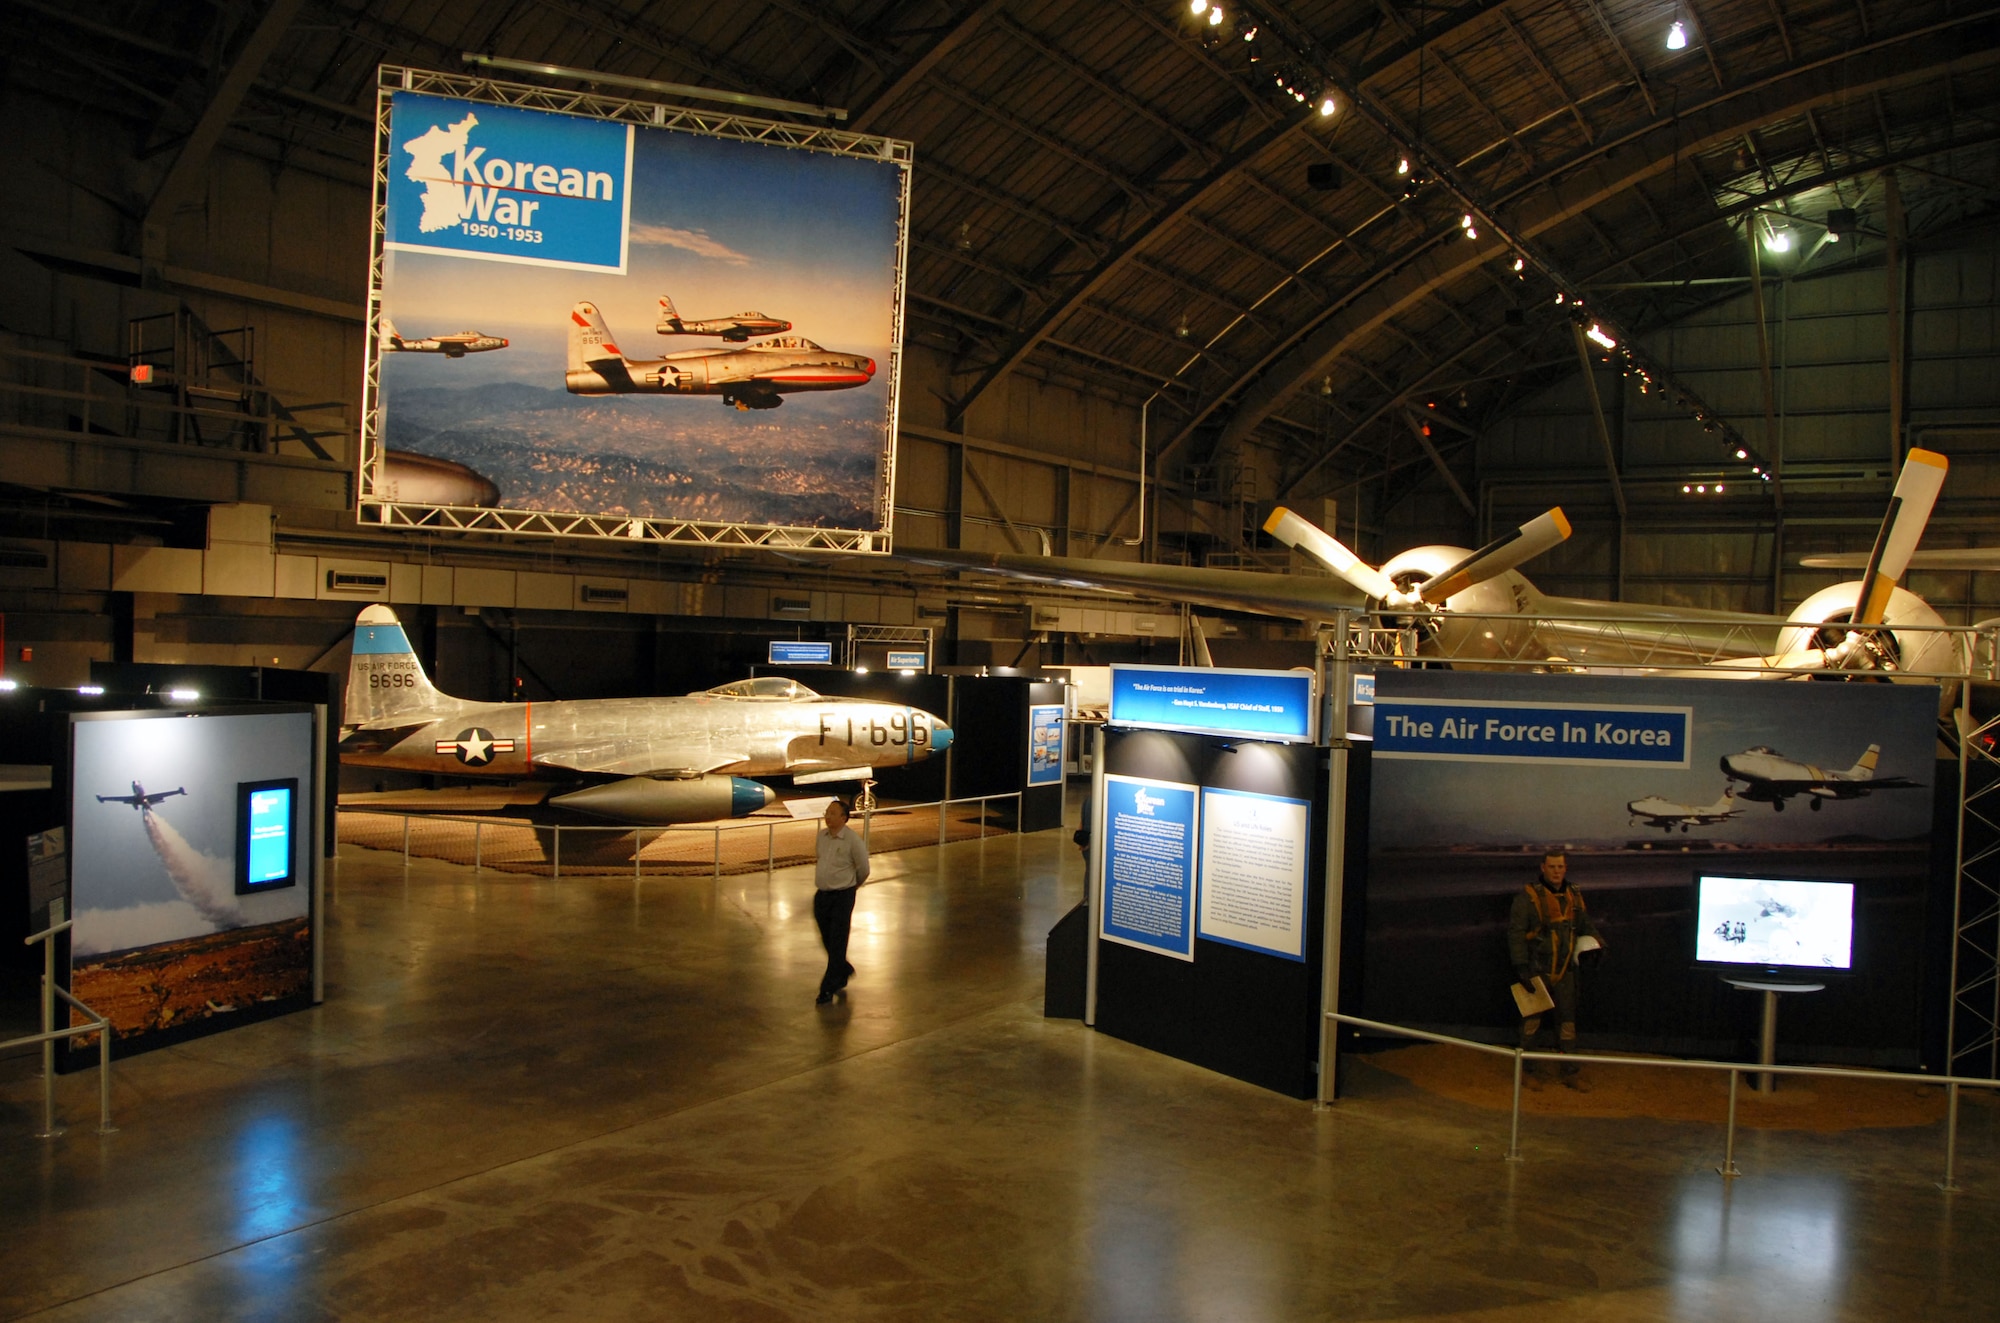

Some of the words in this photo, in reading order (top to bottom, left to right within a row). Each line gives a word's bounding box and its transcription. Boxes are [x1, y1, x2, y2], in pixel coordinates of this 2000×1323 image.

[454, 146, 613, 201] Korean
[460, 184, 539, 227] War
[357, 662, 369, 671] US
[372, 662, 385, 671] AIR
[387, 661, 417, 670] FORCE
[369, 673, 414, 688] 9696
[1385, 715, 1434, 738] The
[1439, 718, 1479, 740] Air
[1485, 719, 1556, 743] Force
[1562, 722, 1587, 743] In
[1594, 722, 1671, 746] Korea
